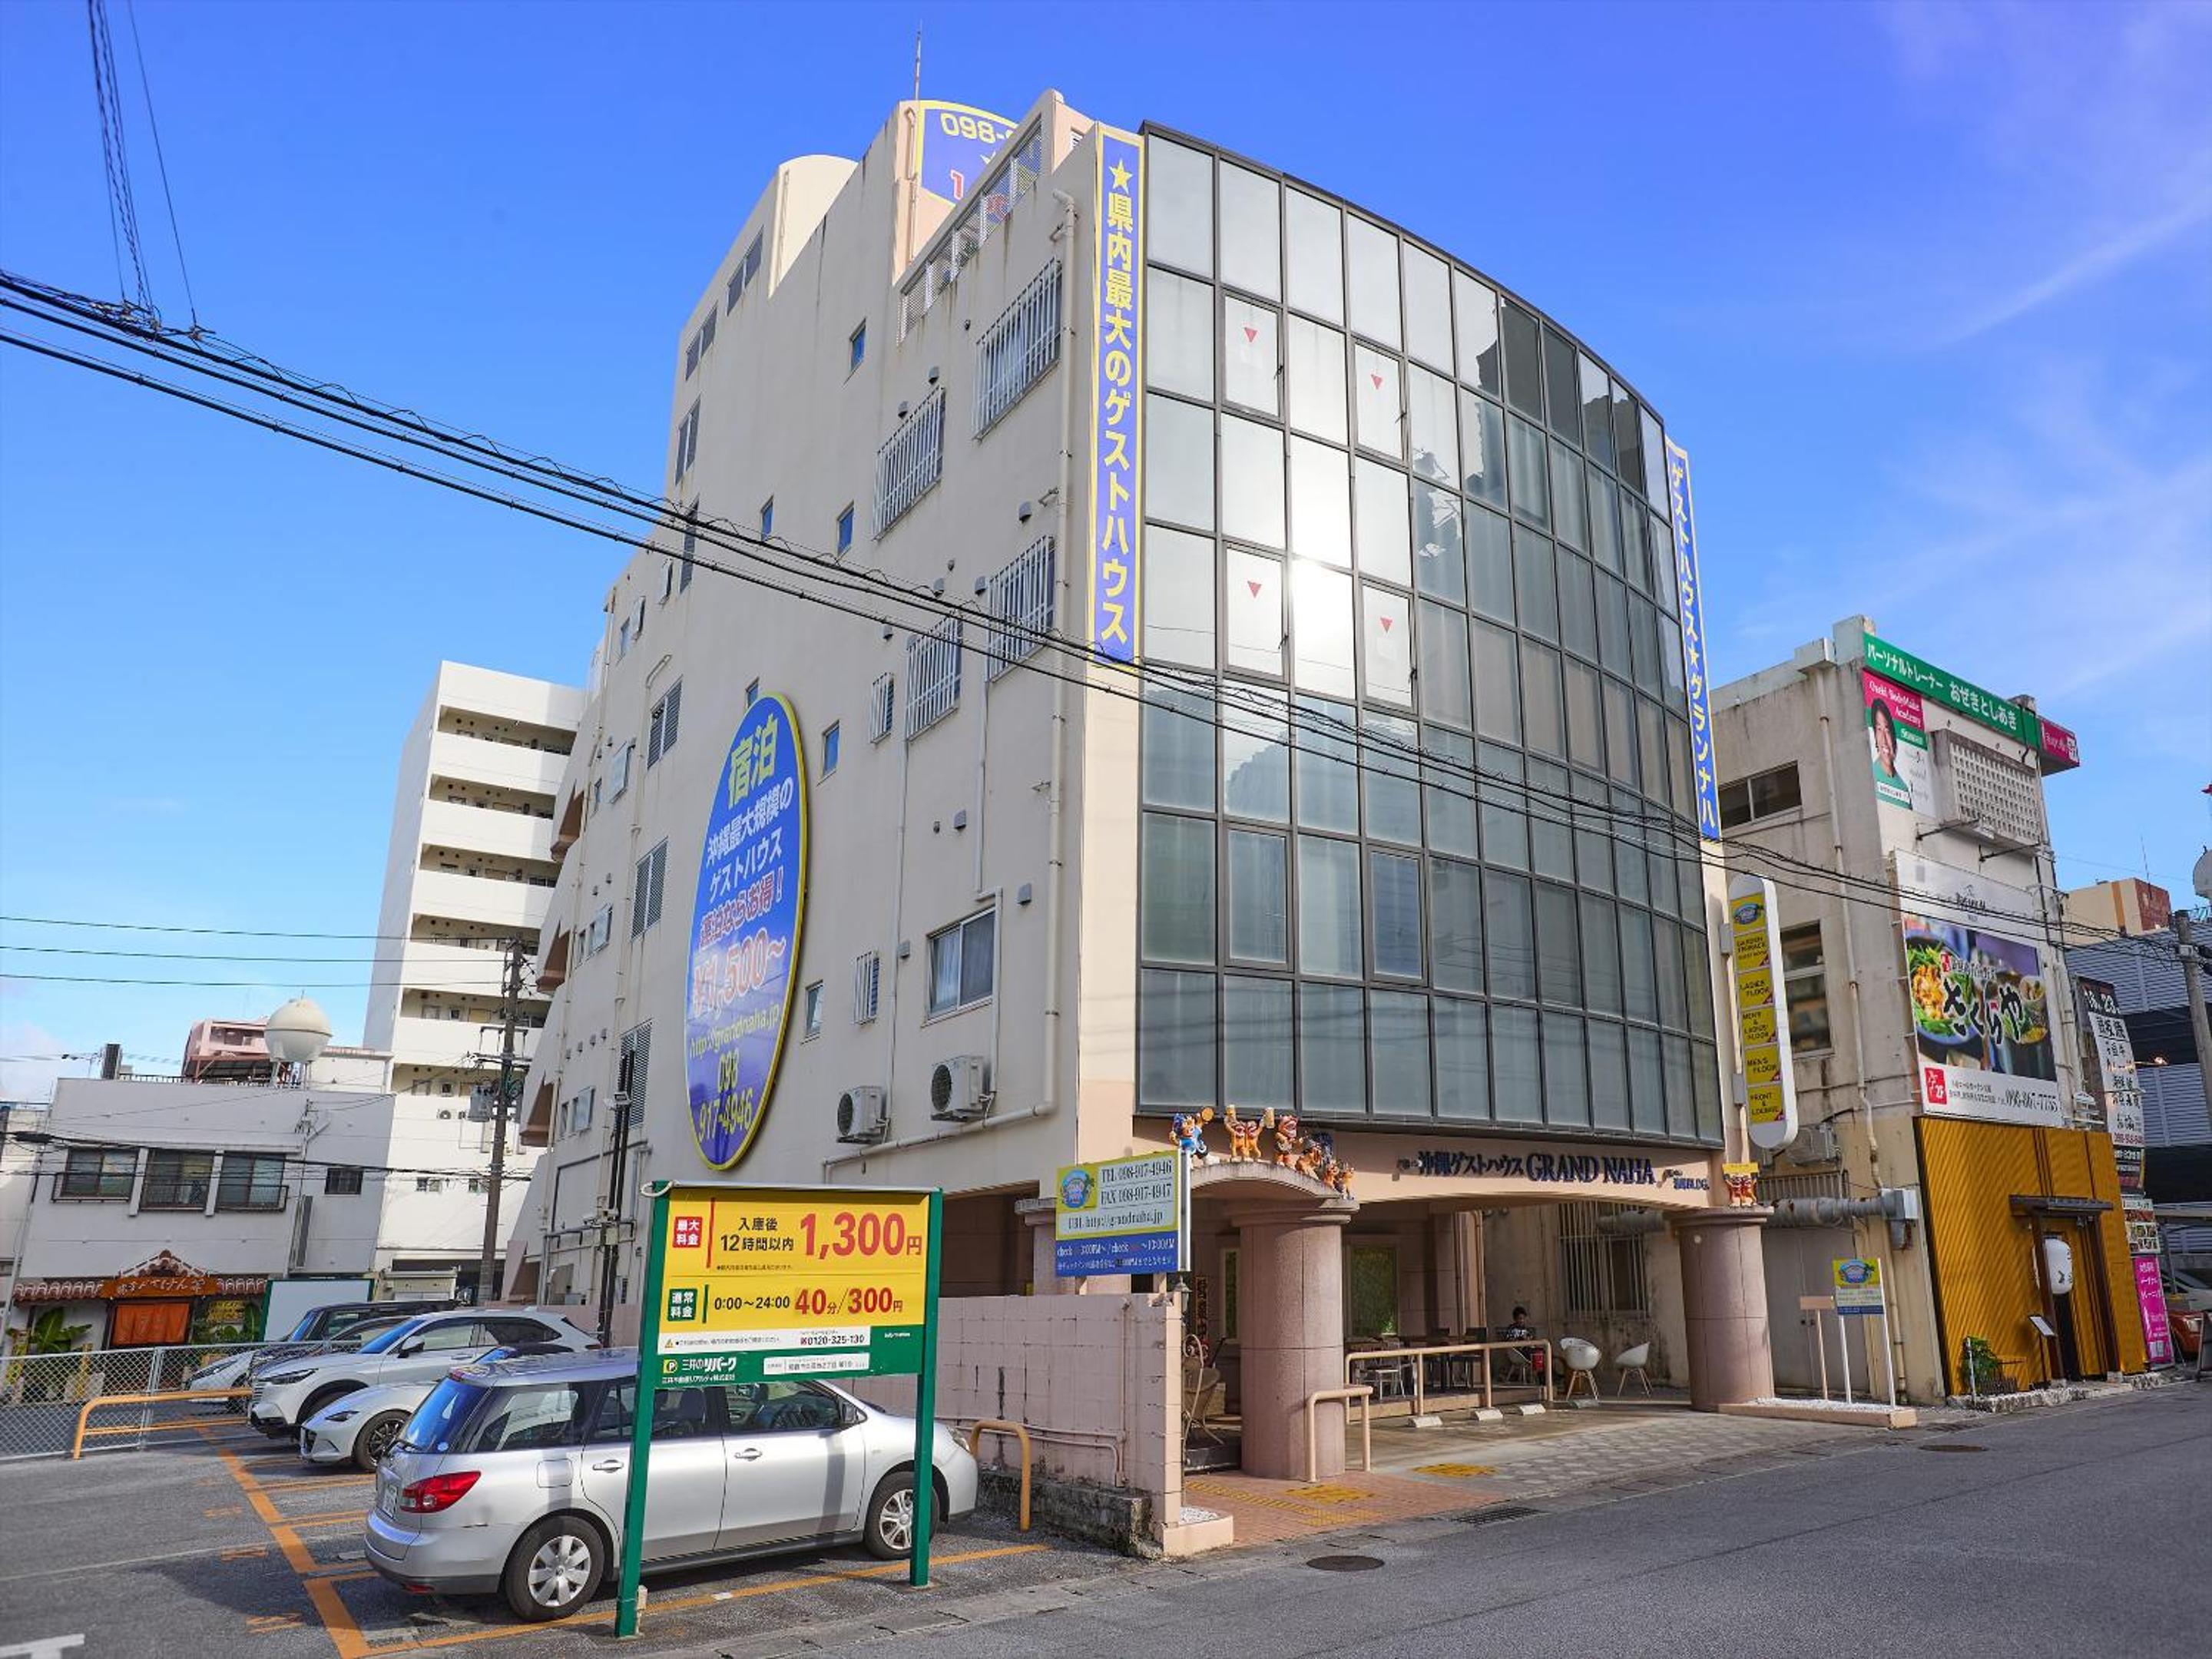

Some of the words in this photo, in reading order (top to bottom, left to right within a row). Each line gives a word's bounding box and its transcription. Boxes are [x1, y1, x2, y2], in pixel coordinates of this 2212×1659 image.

[1101, 191, 1134, 644] 県内最大のゲストハウス
[1867, 643, 1945, 689] パーソナルトレーナー
[1949, 680, 2018, 731] おぜきとしあき
[729, 714, 779, 810] 宿泊
[706, 777, 794, 869] 沖縄最大規模の
[710, 826, 783, 904] ゲストハウス
[1418, 1151, 1525, 1177] 沖縄ゲストハウス
[1526, 1154, 1599, 1183] GRAND
[1603, 1157, 1657, 1185] NAHA
[720, 1234, 794, 1252] 12時間以内
[738, 1217, 778, 1230] 入庫後
[682, 1356, 737, 1373] 三井のリパーク
[808, 1334, 865, 1346] 0120-325-130
